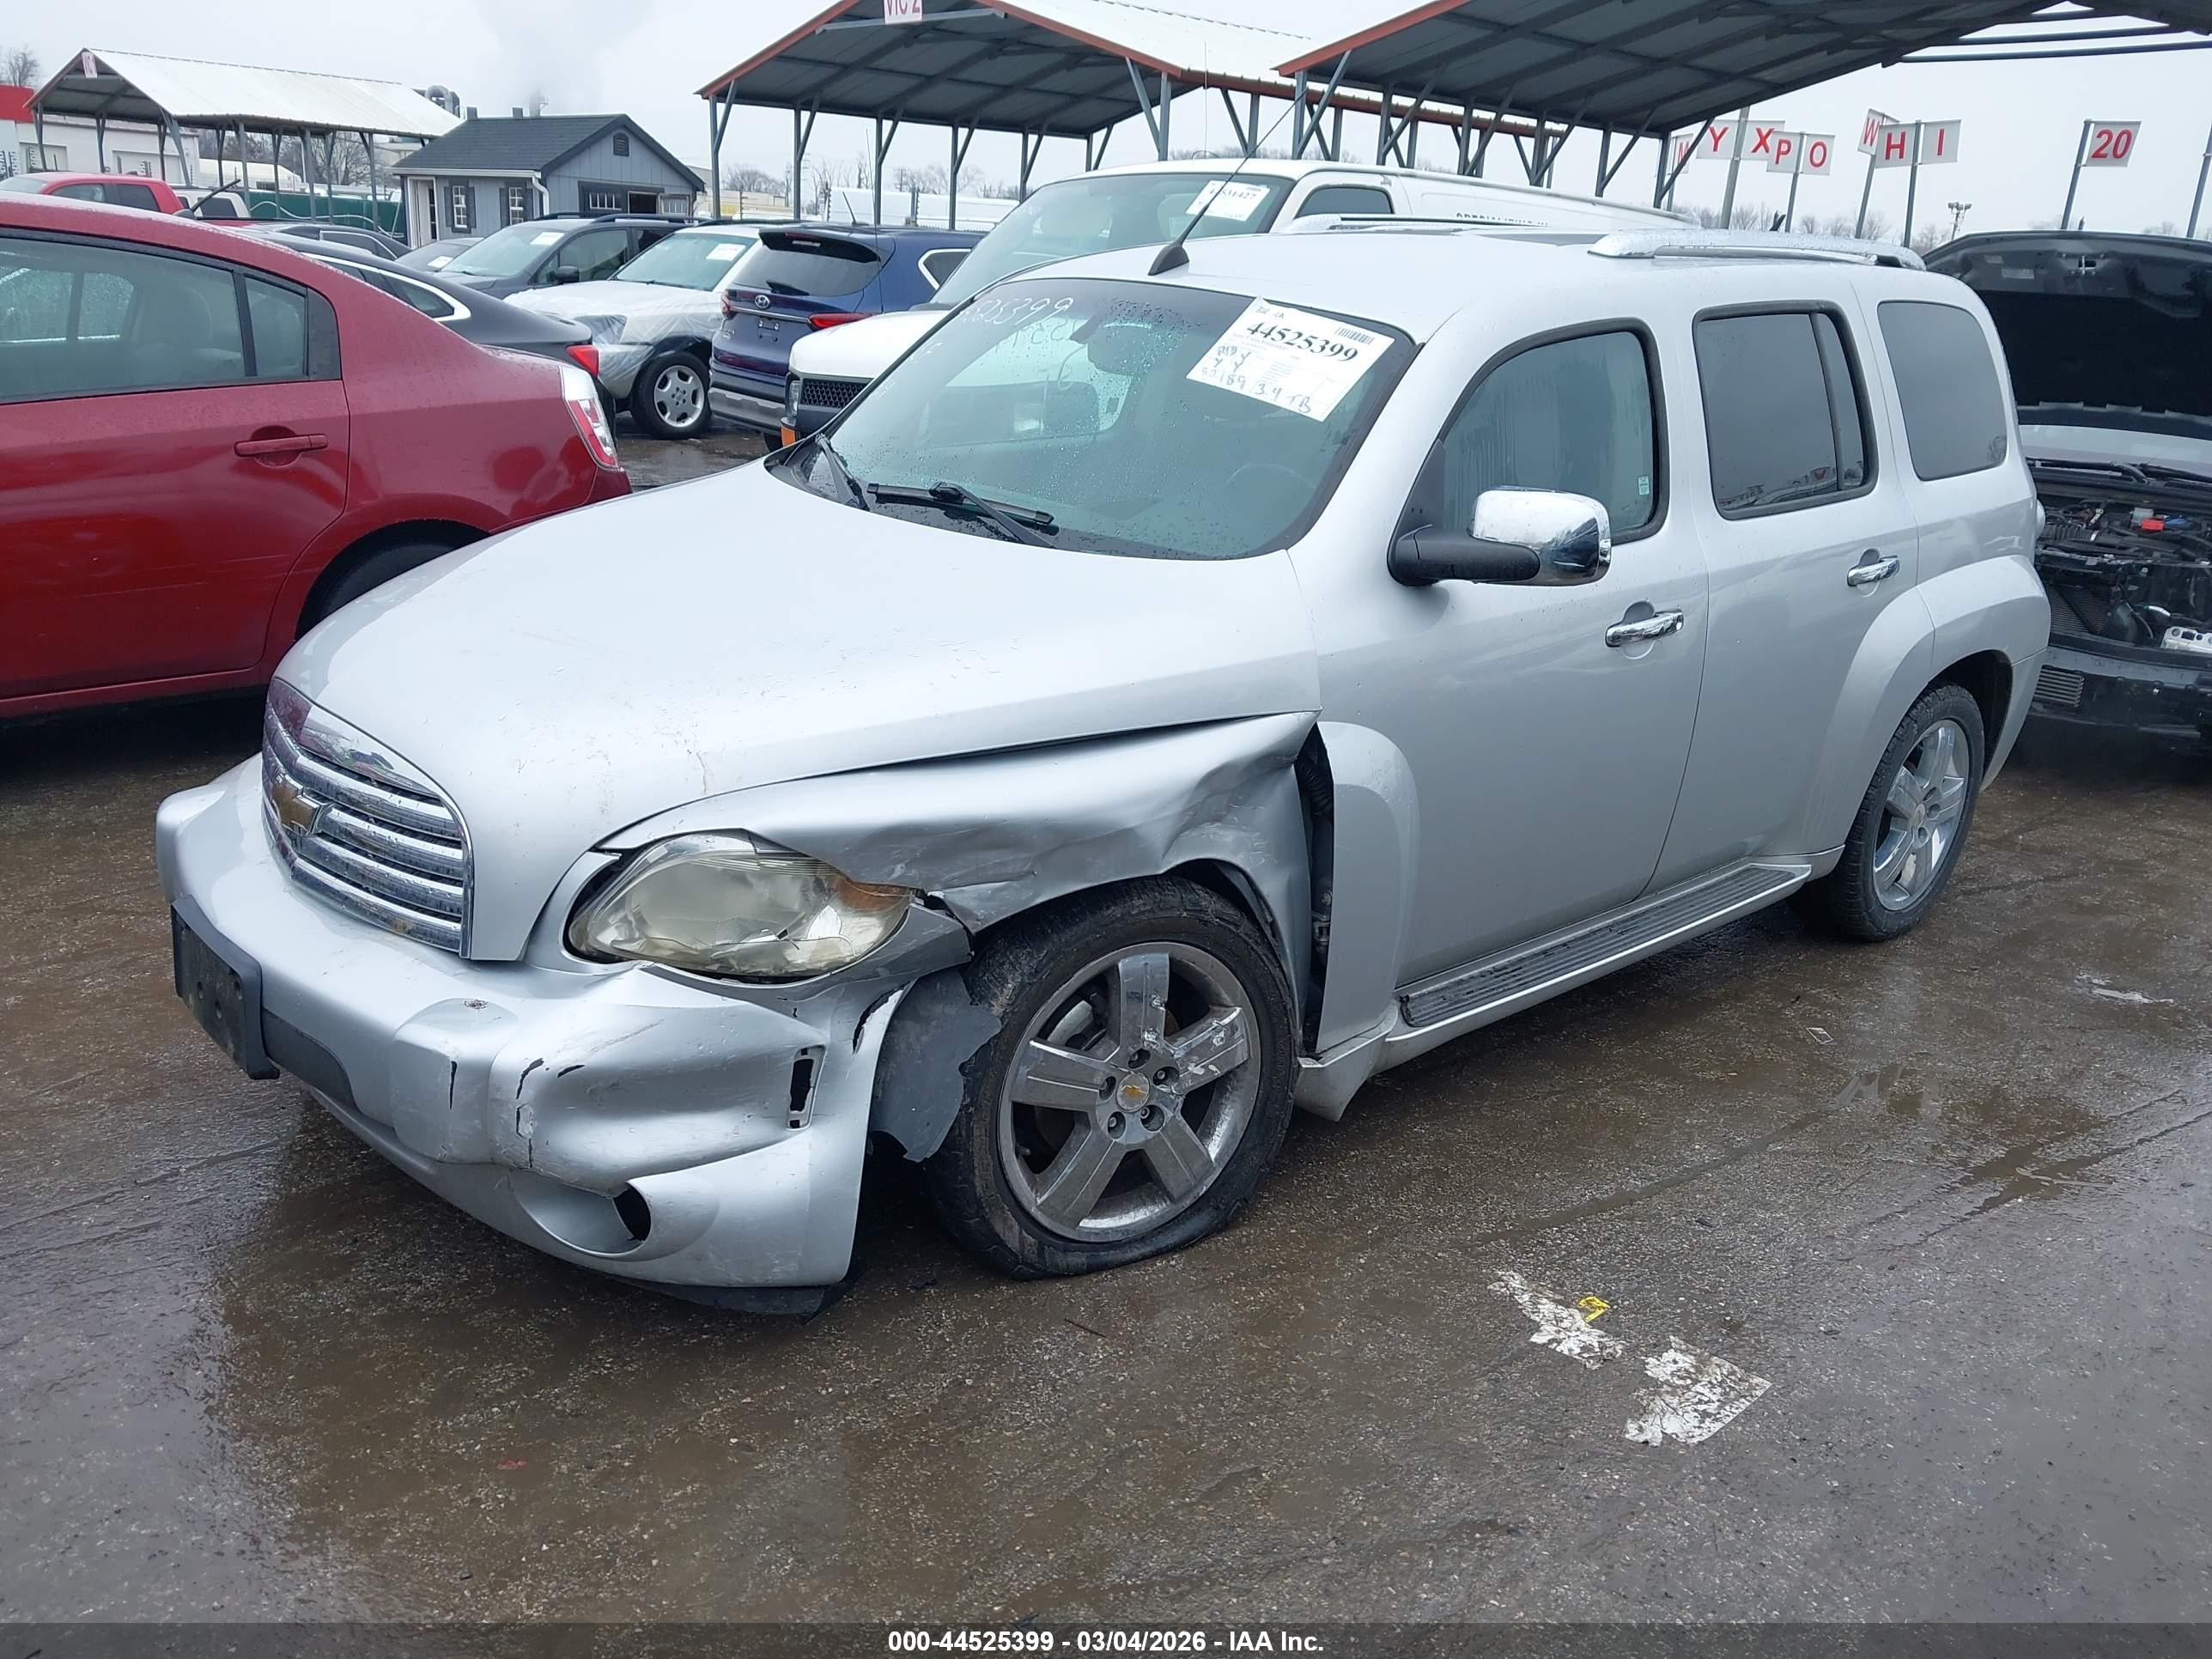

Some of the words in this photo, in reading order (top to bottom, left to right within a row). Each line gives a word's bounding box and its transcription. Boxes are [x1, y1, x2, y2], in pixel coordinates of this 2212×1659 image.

[1708, 126, 1729, 152] Y
[1751, 127, 1775, 154] X
[1775, 138, 1792, 165] P
[1885, 131, 1906, 160] H
[1936, 128, 1945, 156] I
[2091, 129, 2133, 159] 20
[1246, 322, 1358, 362] 44525399
